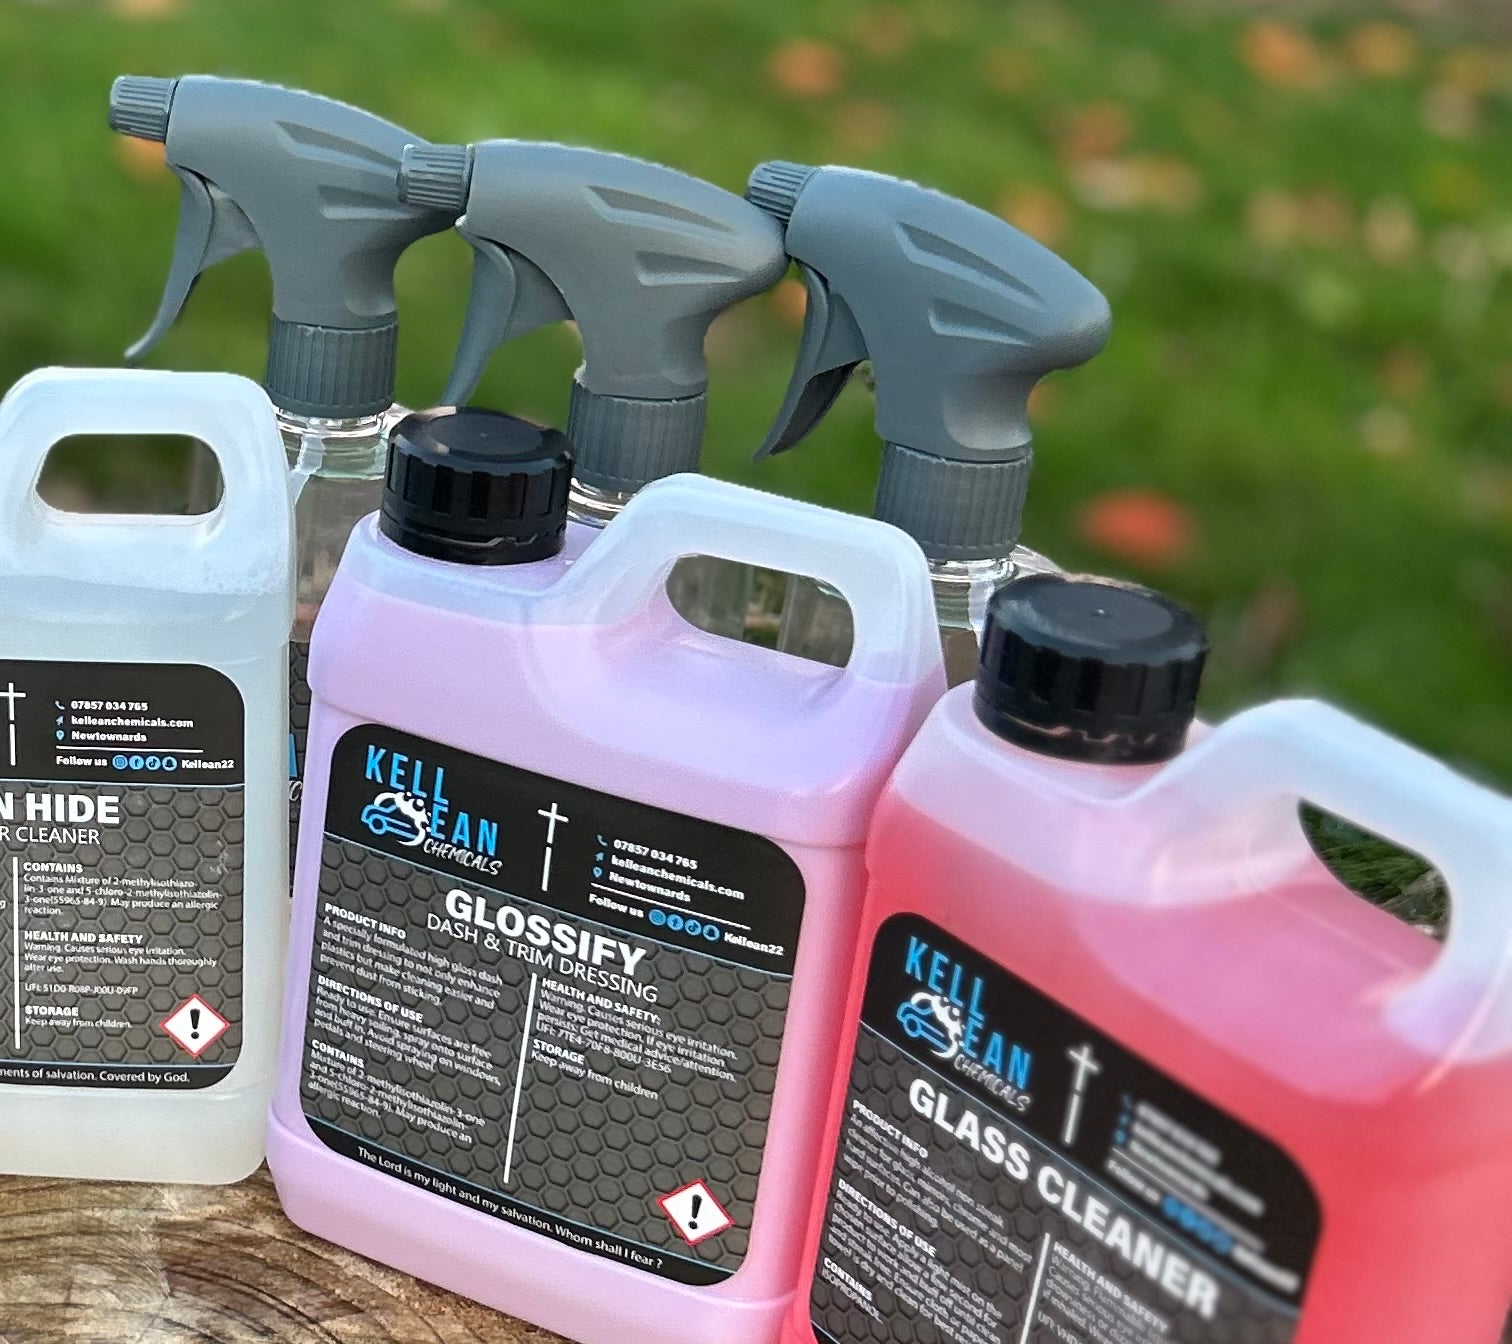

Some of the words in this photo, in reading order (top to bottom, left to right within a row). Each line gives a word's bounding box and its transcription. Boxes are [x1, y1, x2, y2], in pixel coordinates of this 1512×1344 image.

[71, 701, 103, 710] 07857
[106, 702, 126, 710] 034
[128, 702, 148, 710] 765
[72, 716, 193, 727] kelleanchemicals.com
[72, 731, 146, 741] Newtownards
[56, 756, 92, 765] Follow
[182, 760, 234, 769] Kellean22
[366, 745, 448, 805] KELL
[26, 793, 119, 824] HIDE
[16, 827, 100, 844] CLEANER
[614, 840, 649, 856] 07857
[651, 850, 673, 863] 034
[676, 856, 697, 869] 765
[24, 862, 83, 873] CONTAINS
[424, 836, 502, 875] CHEMICALS
[609, 872, 690, 902] Newtownards
[612, 855, 744, 900] kelleanchemicals.com
[24, 931, 68, 941] HEALTH
[71, 933, 96, 942] AND
[99, 934, 142, 944] SAFETY
[325, 903, 377, 928] PRODUCT
[379, 922, 406, 939] INFO
[446, 890, 646, 976] GLOSSIFY
[589, 894, 627, 912] Follow
[630, 908, 644, 917] us
[724, 932, 783, 955] Kellean22
[333, 921, 371, 942] specially
[374, 933, 426, 960] formulated
[428, 952, 450, 968] high
[452, 962, 477, 977] gloss
[478, 971, 502, 986] dash
[428, 913, 478, 944] DASH
[486, 933, 499, 952] &
[506, 939, 553, 969] TRIM
[560, 957, 658, 1002] DRESSING
[318, 975, 382, 1007] DIRECTIONS
[384, 1002, 399, 1013] OF
[401, 1007, 423, 1023] USE
[542, 978, 585, 1000] HEALTH
[586, 994, 612, 1008] AND
[906, 936, 984, 1024] KELL
[25, 1005, 78, 1016] STORAGE
[312, 1040, 364, 1068] CONTAINS
[533, 1039, 584, 1064] STORAGE
[32, 1068, 43, 1078] of
[100, 1071, 145, 1081] Covered
[148, 1072, 161, 1083] by
[164, 1072, 190, 1082] God.
[532, 1050, 557, 1067] Keep
[559, 1062, 584, 1077] away
[588, 1069, 612, 1085] from
[614, 1080, 658, 1100] children
[954, 1049, 1030, 1111] CHEMICALS
[853, 1100, 901, 1139] PRODUCT
[902, 1135, 928, 1158] INFO
[358, 1146, 376, 1162] The
[379, 1156, 402, 1173] Lord
[404, 1166, 412, 1177] is
[414, 1173, 430, 1185] my
[433, 1178, 456, 1195] light
[459, 1190, 480, 1204] and
[482, 1200, 498, 1212] my
[555, 1224, 592, 1246] Whom
[596, 1240, 622, 1256] shall
[631, 1250, 653, 1265] fear
[910, 1079, 1030, 1180] GLASS
[1038, 1166, 1216, 1315] CLEANER
[839, 1178, 898, 1229] DIRECTIONS
[899, 1225, 913, 1239] OF
[914, 1236, 936, 1257] USE
[824, 1258, 872, 1301] CONTAINS
[1054, 1242, 1096, 1280] HEALTH
[1096, 1276, 1122, 1298] AND
[1123, 1295, 1167, 1331] SAFETY
